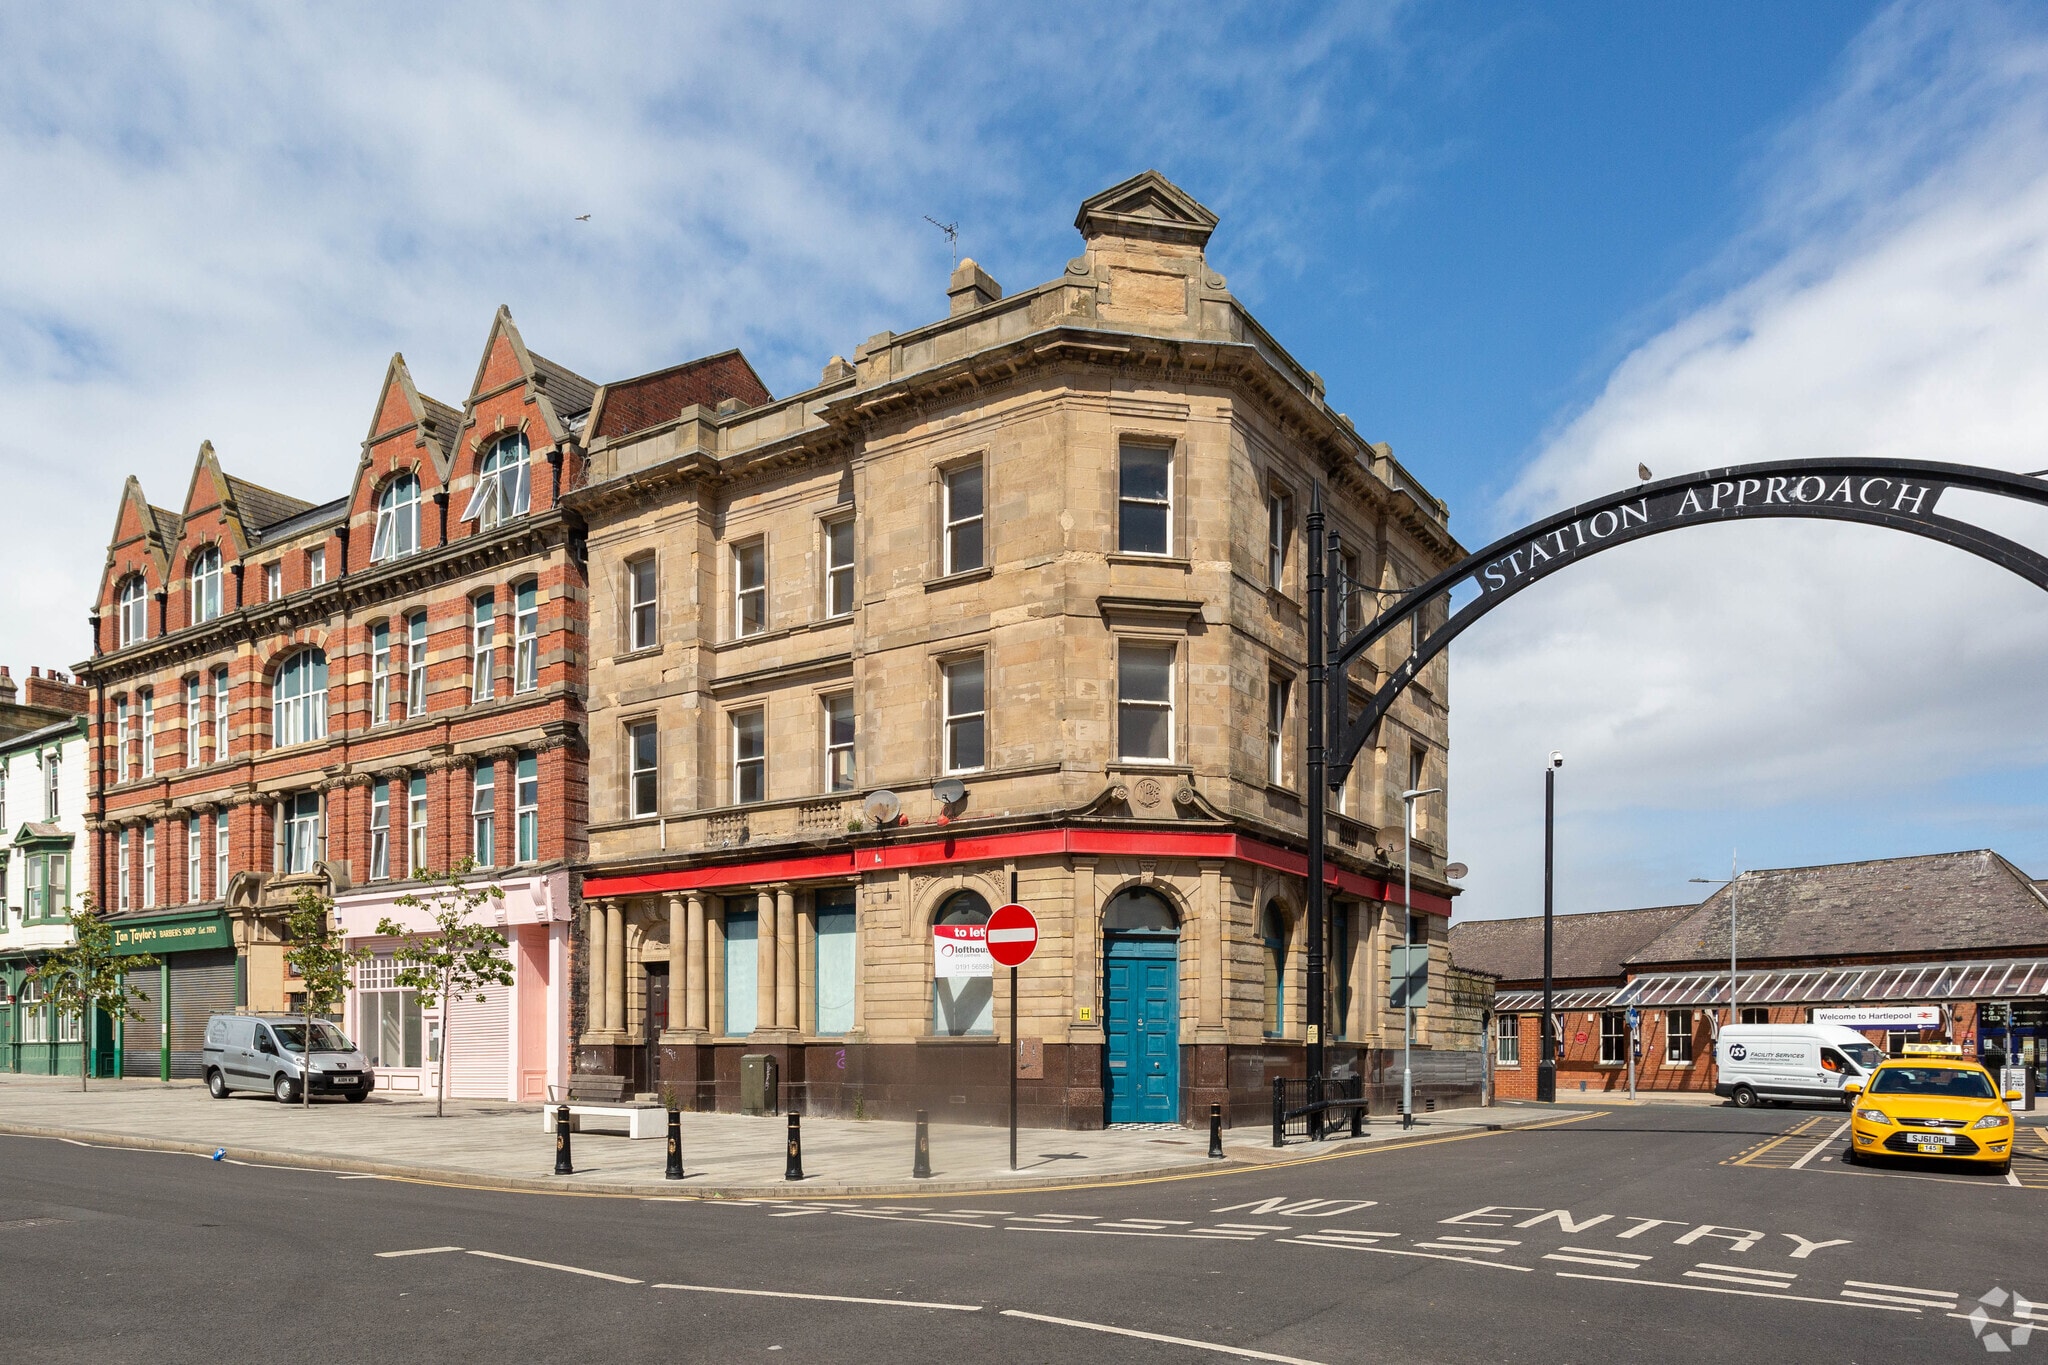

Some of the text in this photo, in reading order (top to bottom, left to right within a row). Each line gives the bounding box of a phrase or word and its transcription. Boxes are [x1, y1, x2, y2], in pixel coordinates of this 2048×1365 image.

[1484, 475, 1931, 592] STATION APPROACH
[114, 929, 128, 946] Ian
[129, 927, 157, 945] Taylor's
[182, 927, 197, 936] SHOP
[954, 927, 986, 938] to let
[1081, 1008, 1090, 1019] H
[1820, 1012, 1856, 1021] Welcome
[1868, 1012, 1911, 1021] Hartlepool
[1907, 1044, 1957, 1052] TAXI
[1912, 1134, 1932, 1143] SJ61
[1210, 1197, 1854, 1258] NO ENTRY
